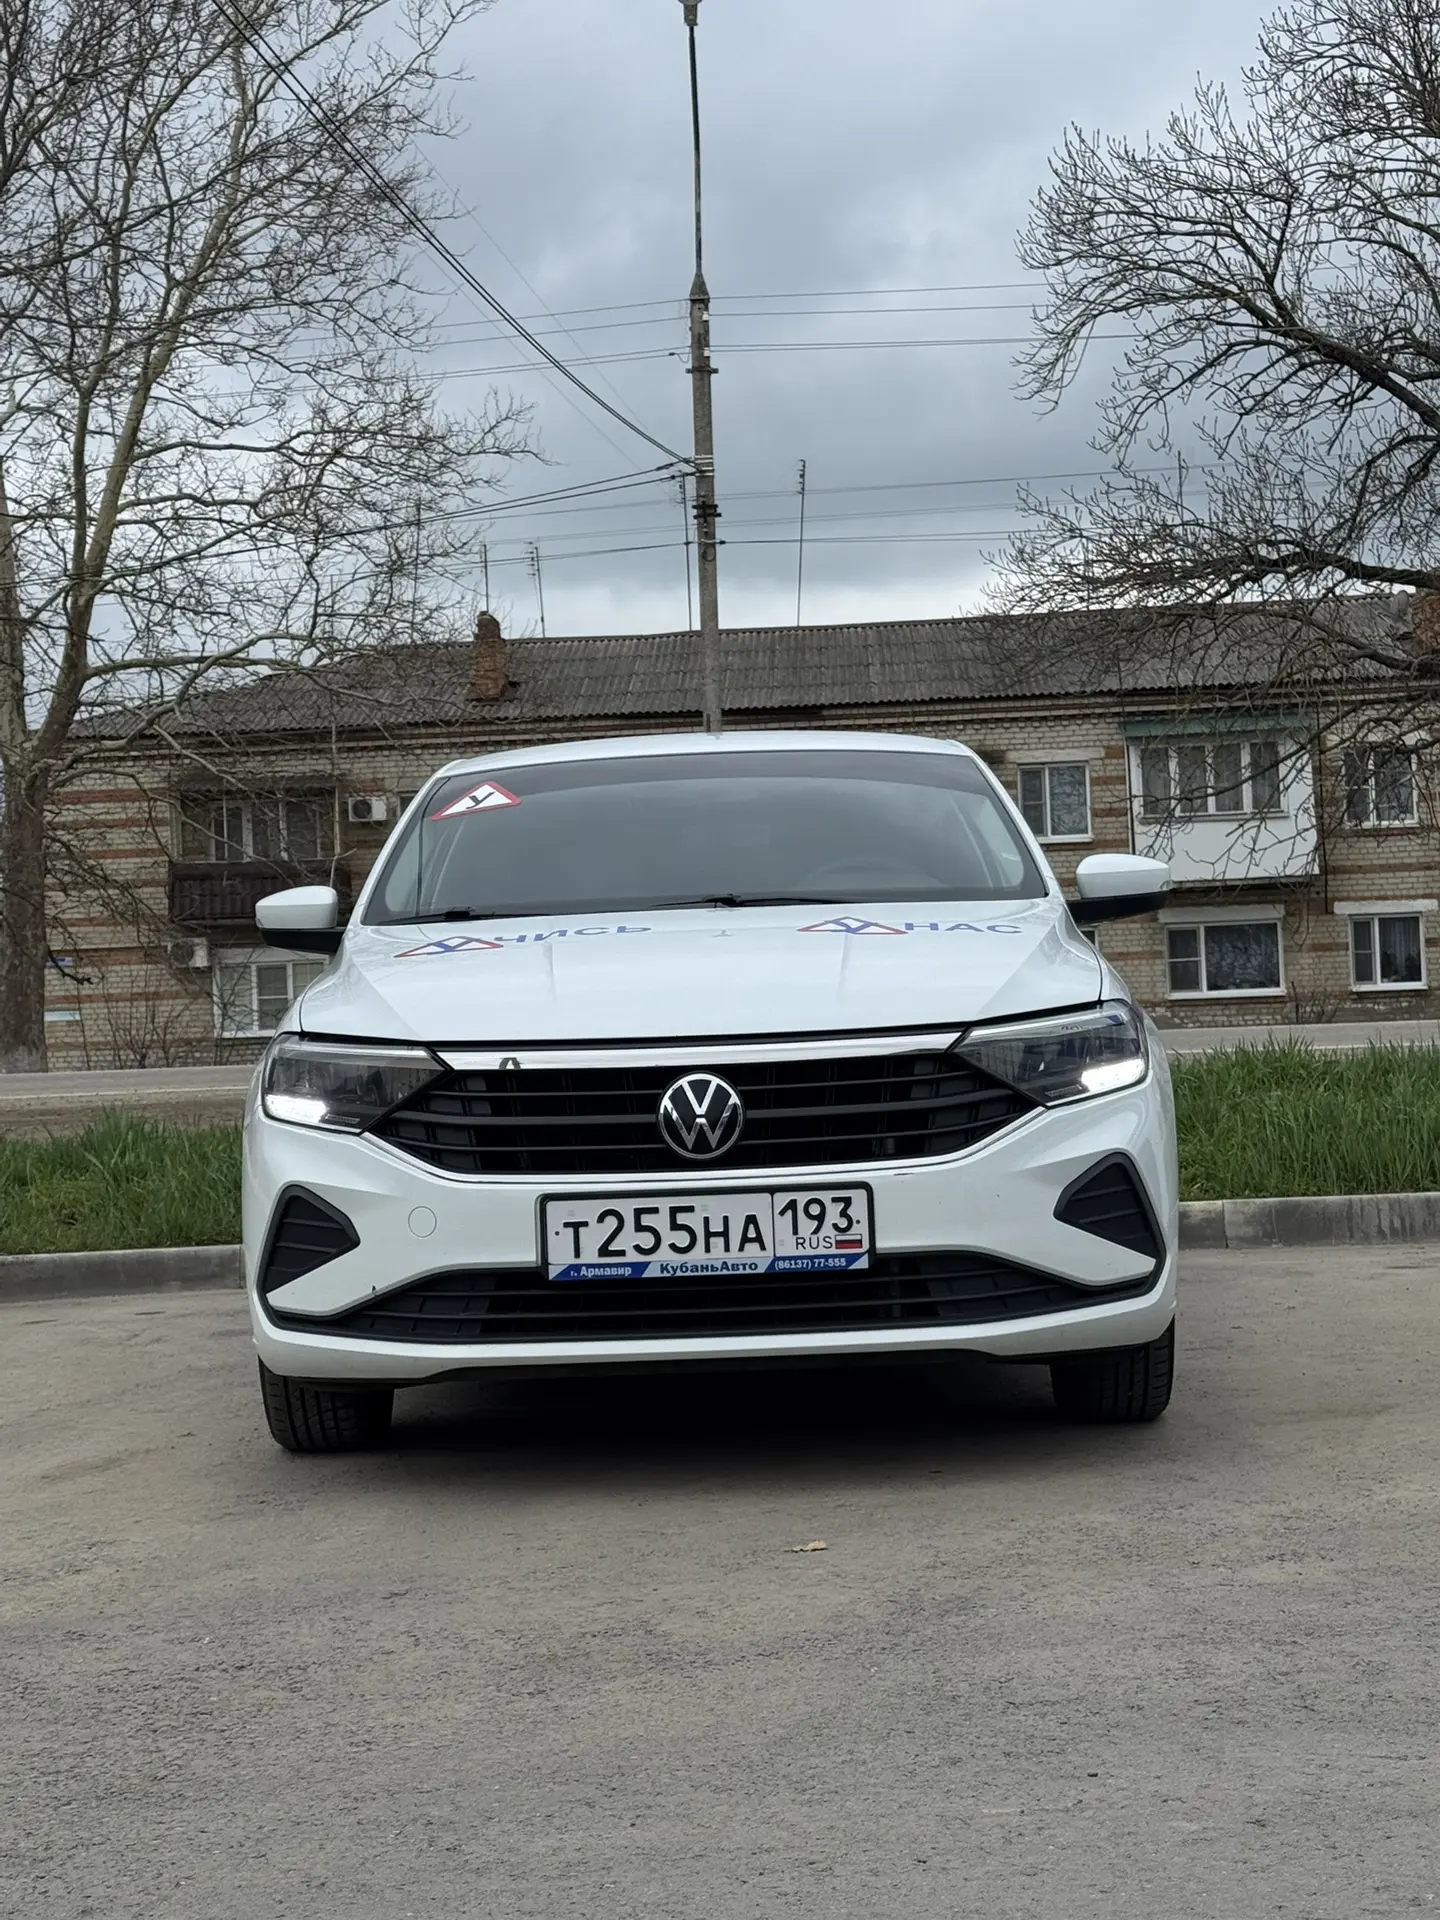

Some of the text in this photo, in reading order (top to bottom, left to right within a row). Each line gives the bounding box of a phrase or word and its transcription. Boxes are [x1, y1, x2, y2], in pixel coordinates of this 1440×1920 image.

[466, 791, 496, 809] У
[904, 922, 1023, 934] НАС
[777, 1195, 854, 1236] 193
[562, 1204, 767, 1259] Т255НА
[795, 1235, 833, 1250] RUS
[659, 1260, 759, 1276] КубаньАвто
[774, 1257, 846, 1270] (86137) 77-555
[579, 1265, 632, 1278] Армавир
